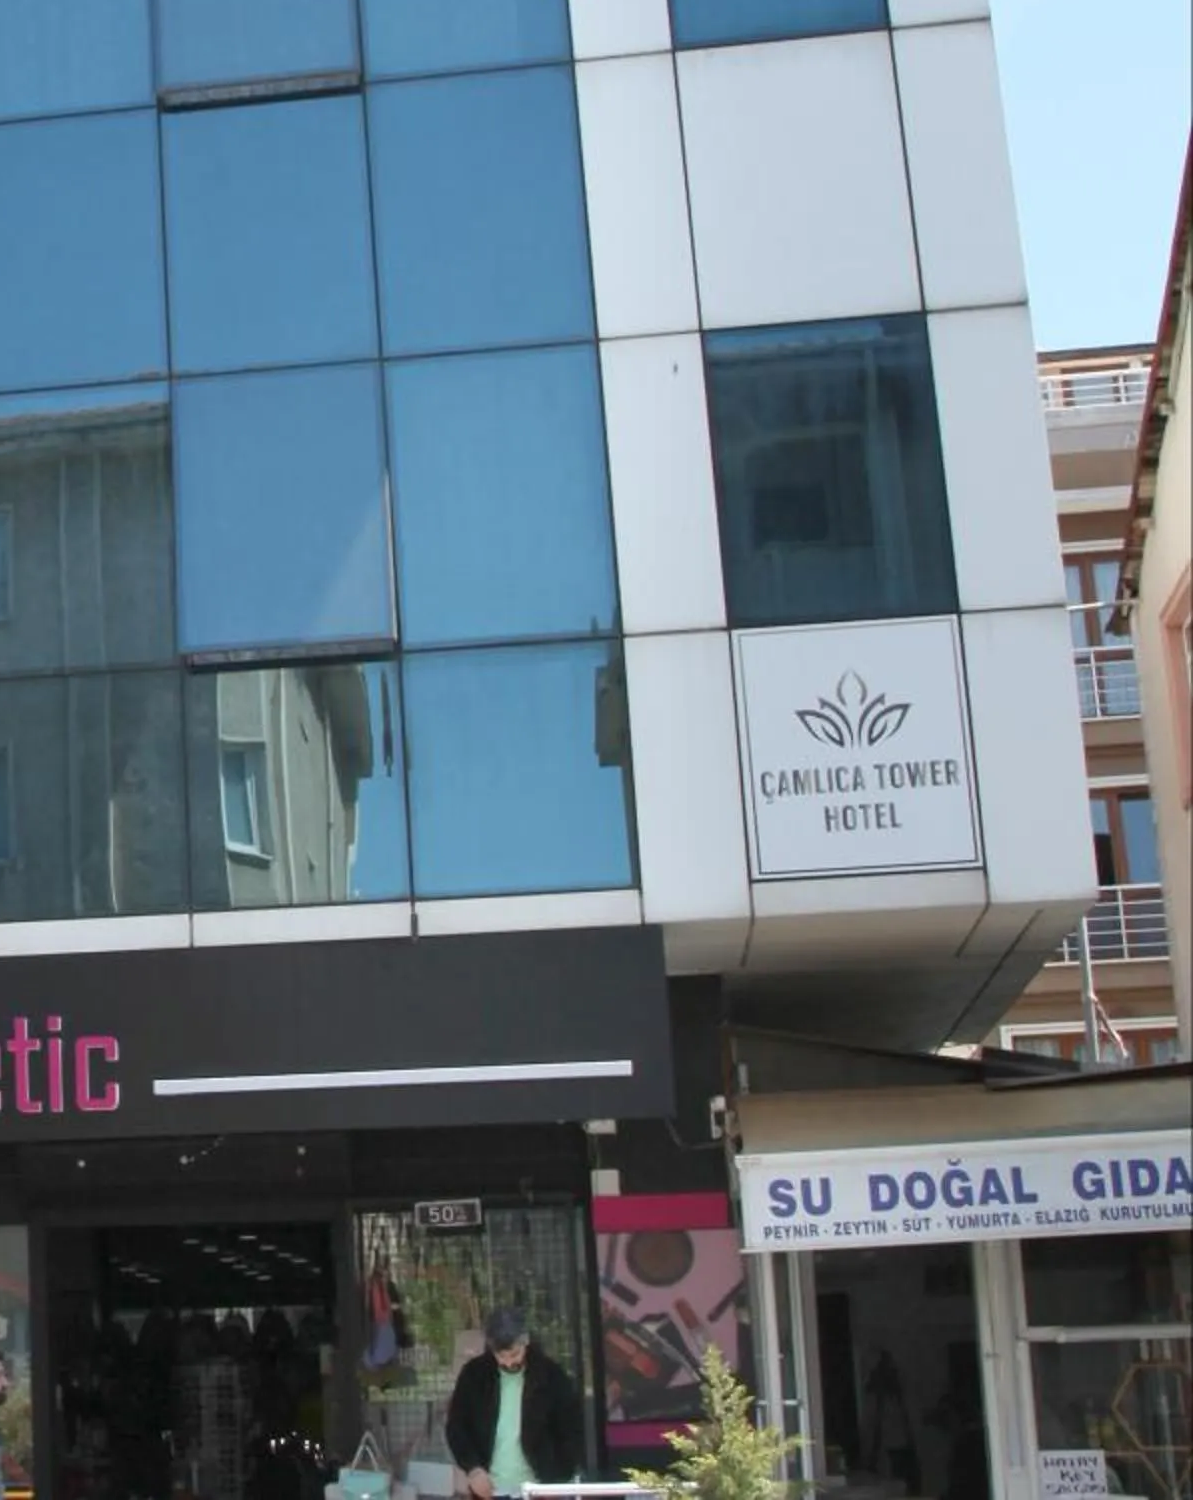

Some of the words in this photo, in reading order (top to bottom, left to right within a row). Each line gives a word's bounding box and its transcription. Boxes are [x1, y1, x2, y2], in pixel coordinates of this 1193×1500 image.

[759, 764, 867, 804] ÇAMLICA
[873, 758, 960, 790] TOWER
[823, 801, 903, 833] HOTEL
[768, 1176, 833, 1219] SU
[868, 1158, 1038, 1213] DOĞAL
[1072, 1156, 1192, 1201] GIDA
[945, 1211, 1021, 1230] YUMURTA
